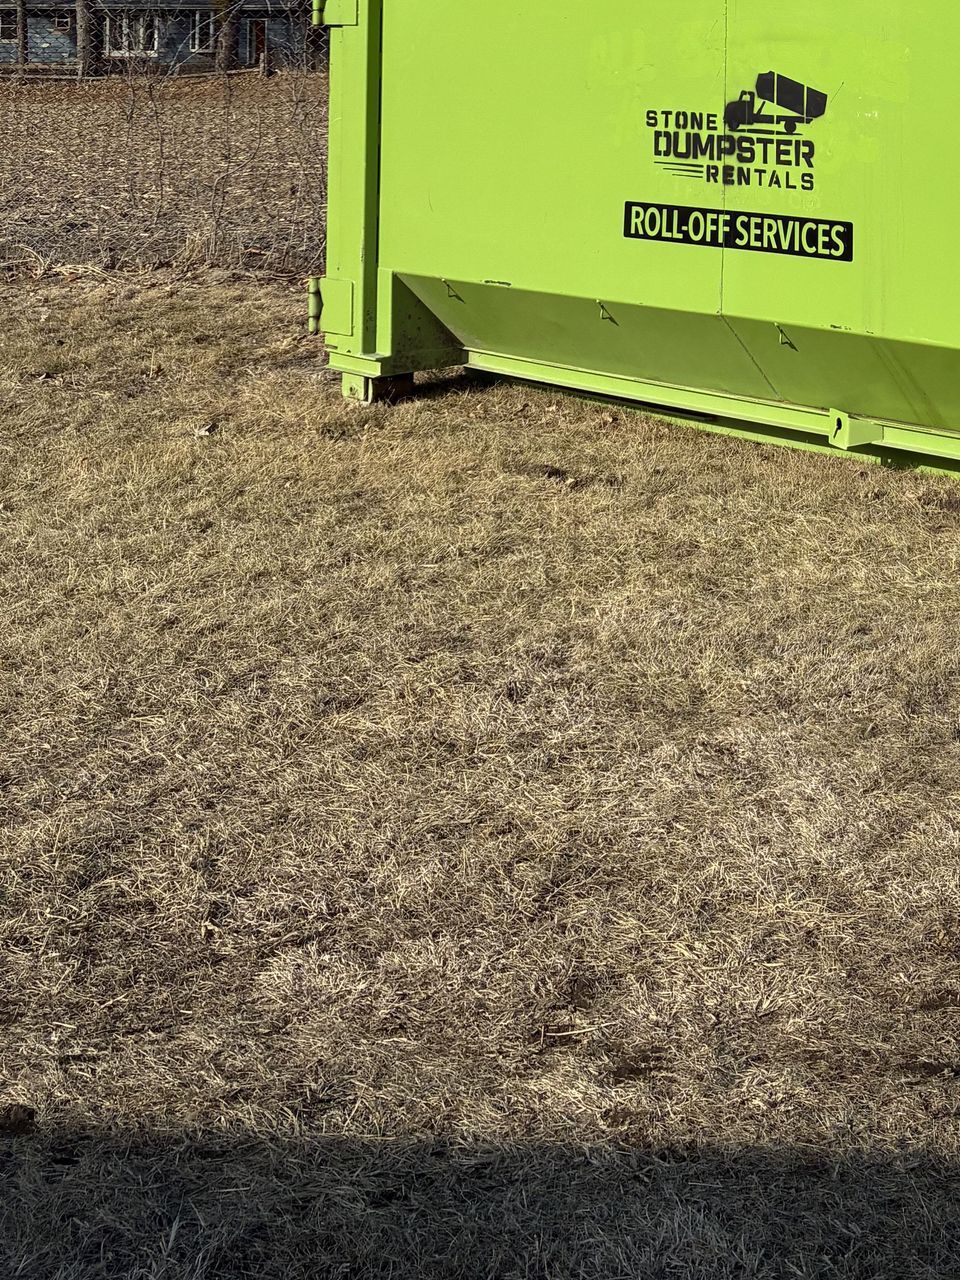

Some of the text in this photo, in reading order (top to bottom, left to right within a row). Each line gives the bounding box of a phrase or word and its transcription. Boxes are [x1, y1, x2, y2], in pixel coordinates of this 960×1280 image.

[646, 110, 718, 131] STONE
[654, 131, 815, 168] DUMPSTER
[706, 164, 814, 191] RENTALS
[630, 206, 845, 257] ROLL-OFF SERVICES
